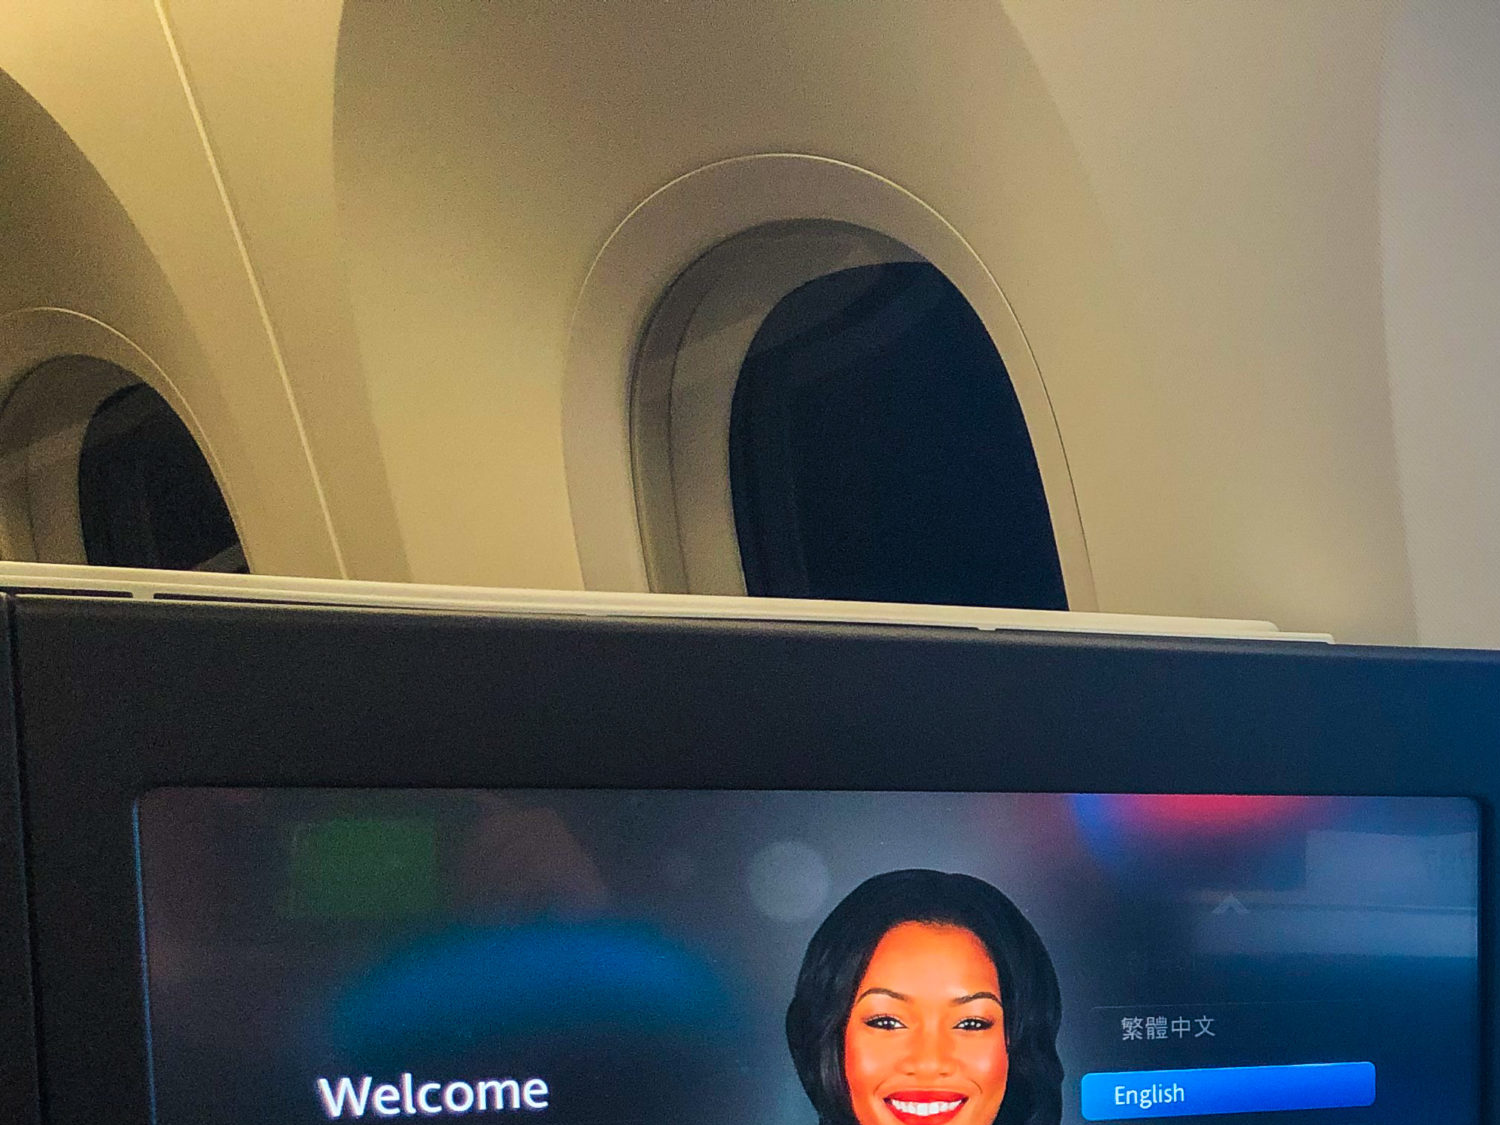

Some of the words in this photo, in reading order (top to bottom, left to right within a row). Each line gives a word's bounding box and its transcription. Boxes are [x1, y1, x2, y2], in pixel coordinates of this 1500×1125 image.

[1120, 1015, 1216, 1041] 繁體中文
[317, 1072, 549, 1118] Welcome
[1114, 1083, 1185, 1109] English
